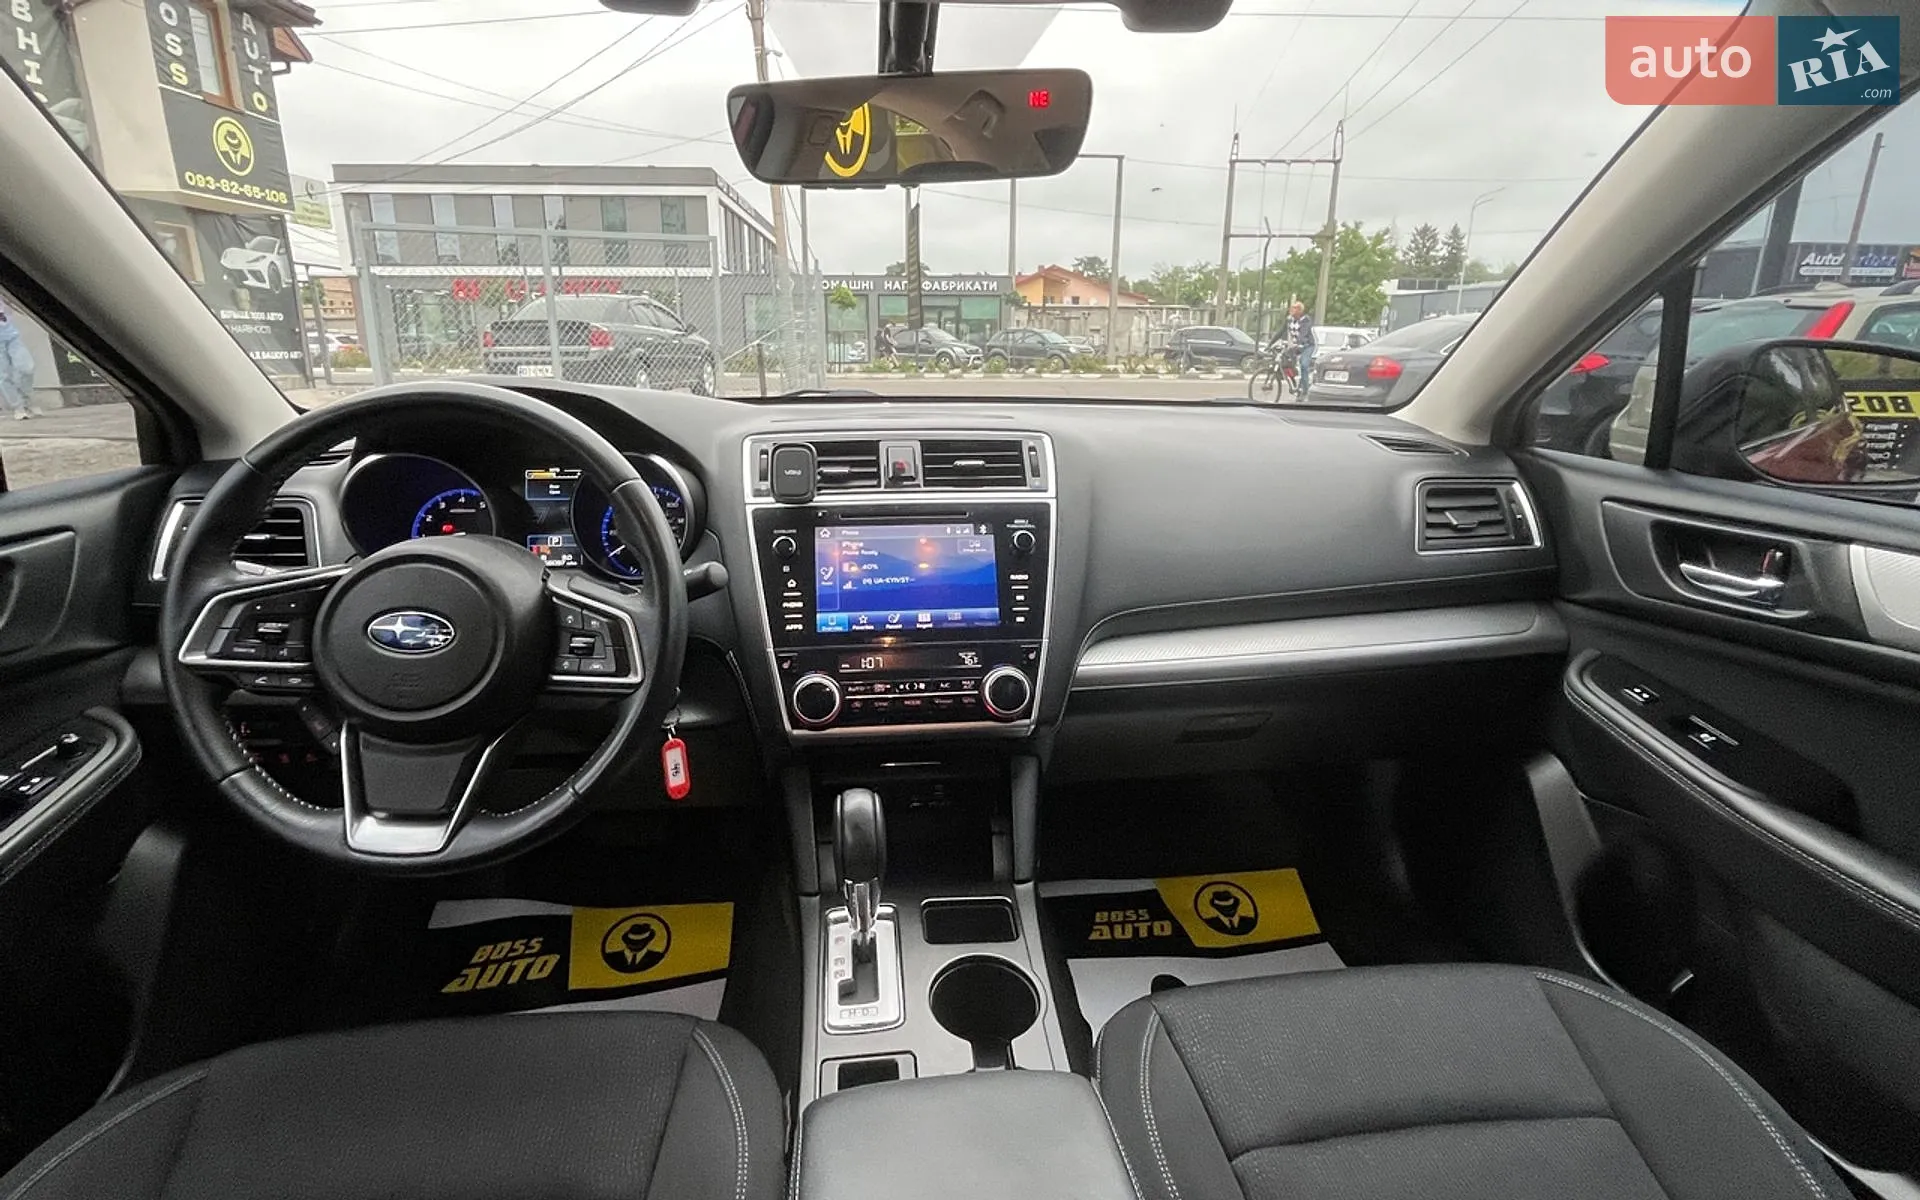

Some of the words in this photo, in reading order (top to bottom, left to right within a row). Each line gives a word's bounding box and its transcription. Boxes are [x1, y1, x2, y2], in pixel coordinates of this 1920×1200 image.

[242, 12, 268, 112] AUTO
[1029, 90, 1048, 106] NE
[1095, 909, 1150, 922] BOSS
[1088, 920, 1172, 939] AUTO
[470, 937, 544, 964] BOSS
[441, 954, 560, 992] AUTO
